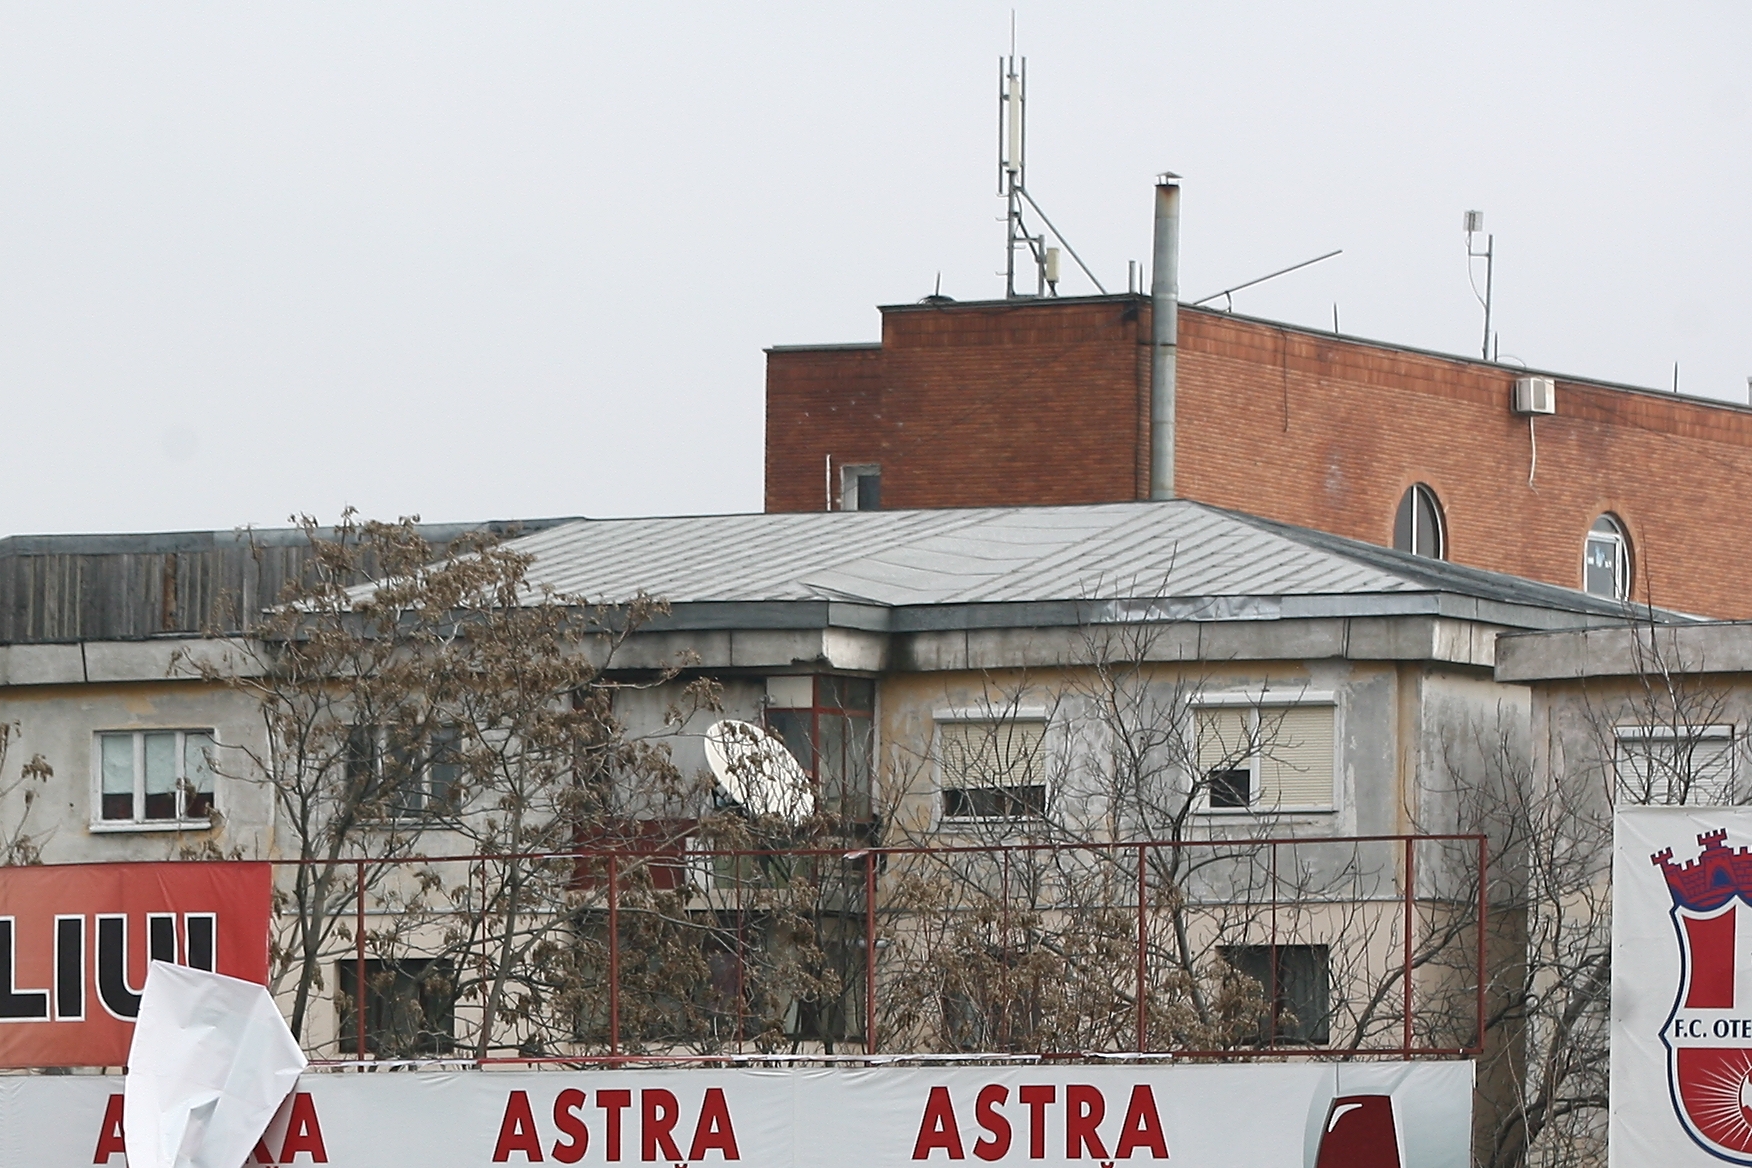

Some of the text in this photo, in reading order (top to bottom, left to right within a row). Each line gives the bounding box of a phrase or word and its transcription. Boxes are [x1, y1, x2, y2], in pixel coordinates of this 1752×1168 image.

[1675, 1018, 1707, 1038] F.C.
[493, 1088, 739, 1163] ASTRA
[913, 1084, 1168, 1161] ASTRA
